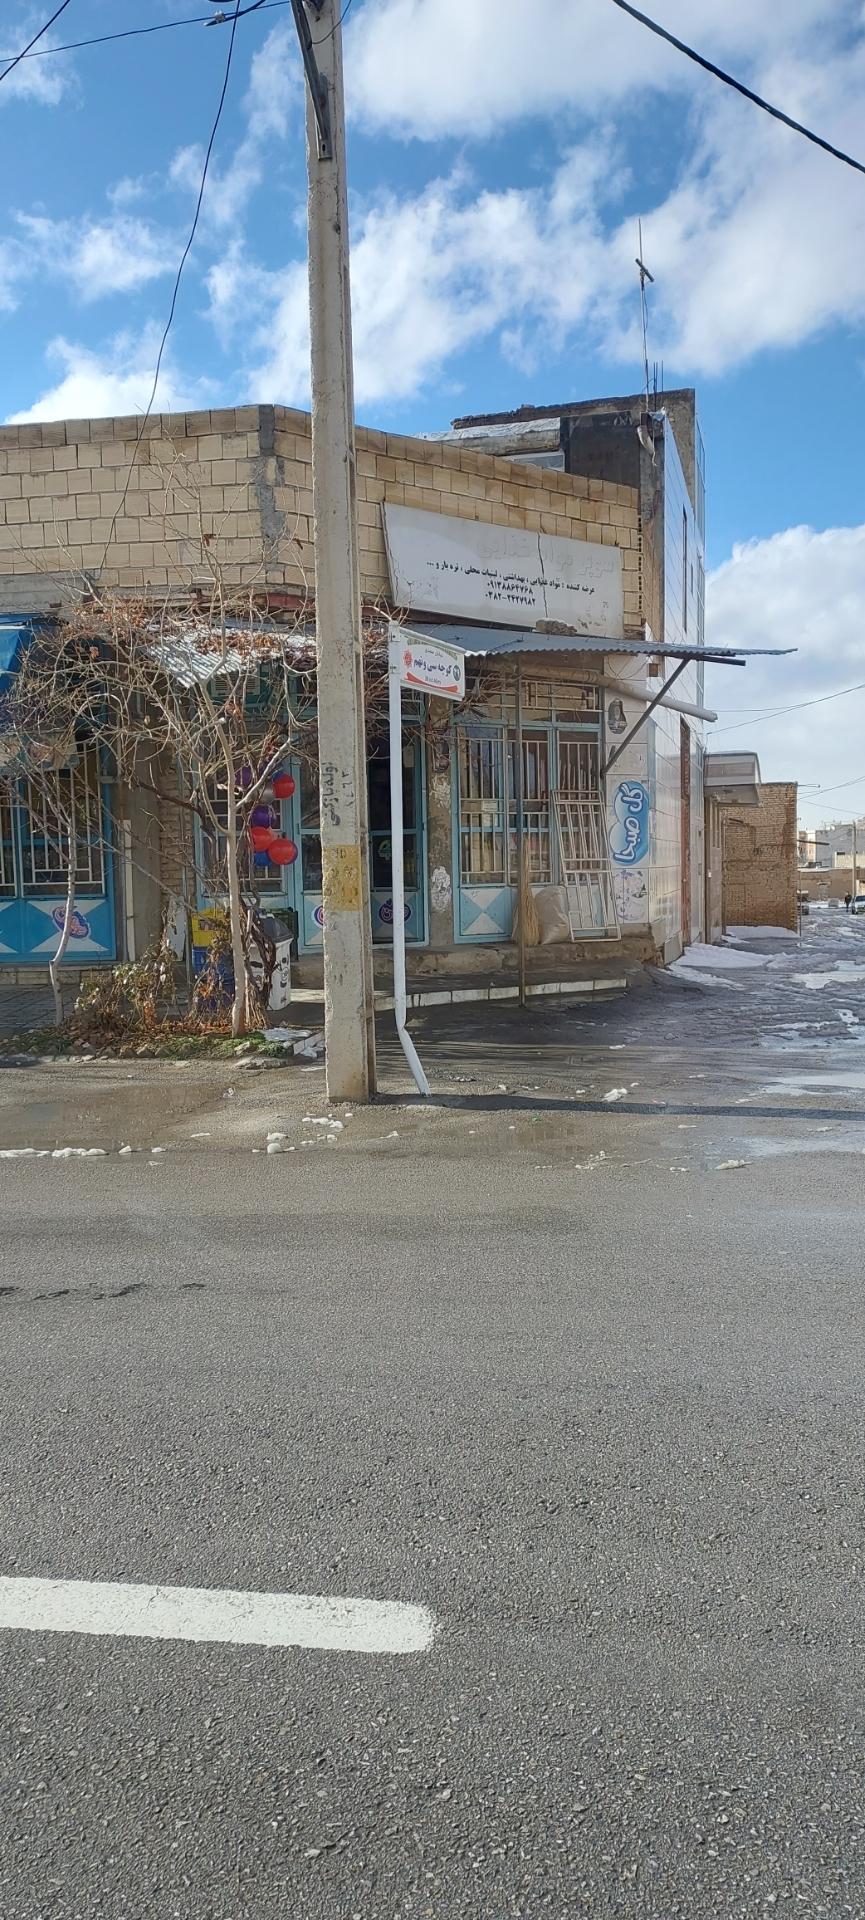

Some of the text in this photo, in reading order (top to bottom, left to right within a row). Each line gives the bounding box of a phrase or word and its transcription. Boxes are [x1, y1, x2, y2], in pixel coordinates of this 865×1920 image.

[441, 560, 449, 571] بار
[450, 562, 459, 572] تره
[464, 565, 480, 575] محلی
[481, 568, 498, 578] لبنیات
[503, 573, 526, 584] بهداشتی
[530, 577, 548, 587] غذایی
[549, 580, 561, 590] مواد
[566, 583, 581, 591] کننده
[582, 587, 595, 596] عرضه
[427, 664, 437, 672] سی
[437, 664, 452, 677] کوچه
[620, 783, 643, 813] گل
